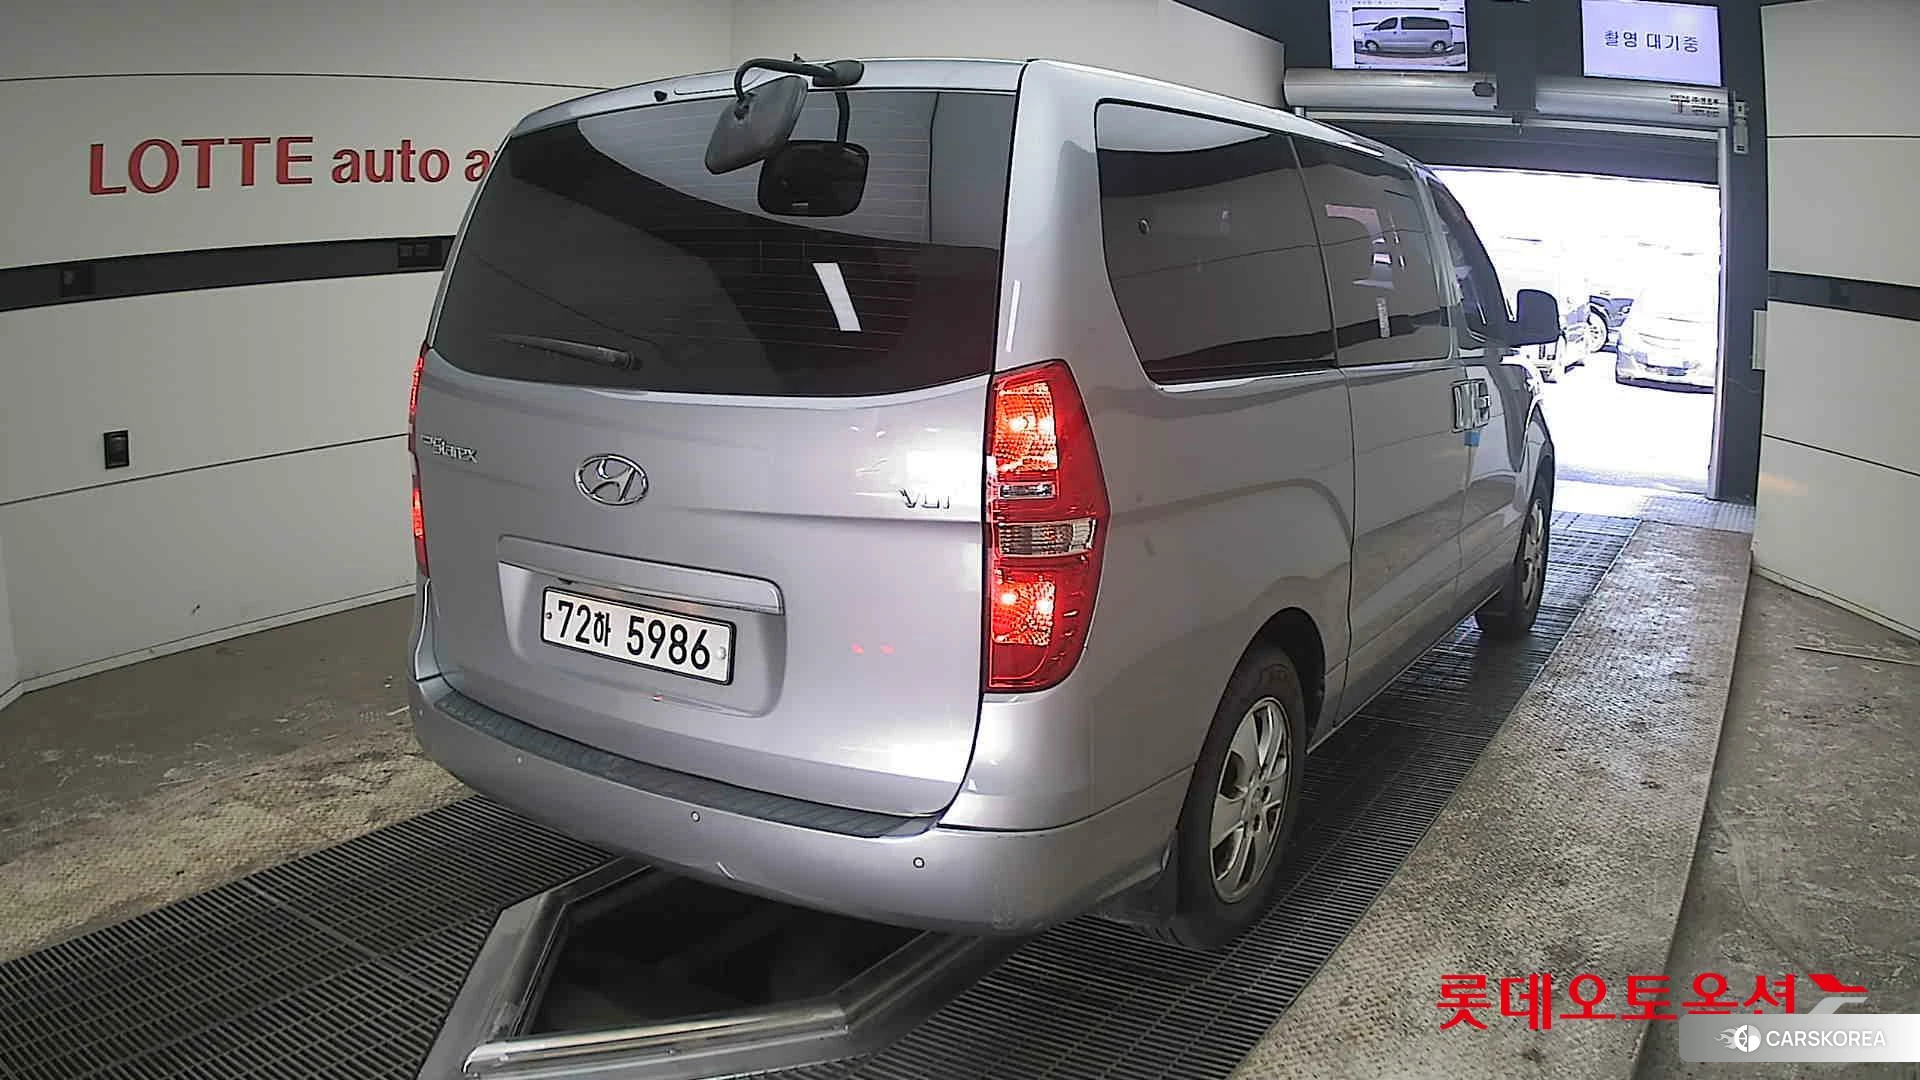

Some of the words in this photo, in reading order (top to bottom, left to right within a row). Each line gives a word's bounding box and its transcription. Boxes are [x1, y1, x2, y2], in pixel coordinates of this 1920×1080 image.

[1646, 33, 1699, 53] 대기중
[90, 136, 313, 195] LOTTE
[331, 139, 450, 184] auto
[464, 149, 495, 182] a
[557, 599, 612, 647] 72하
[626, 615, 711, 671] 5986
